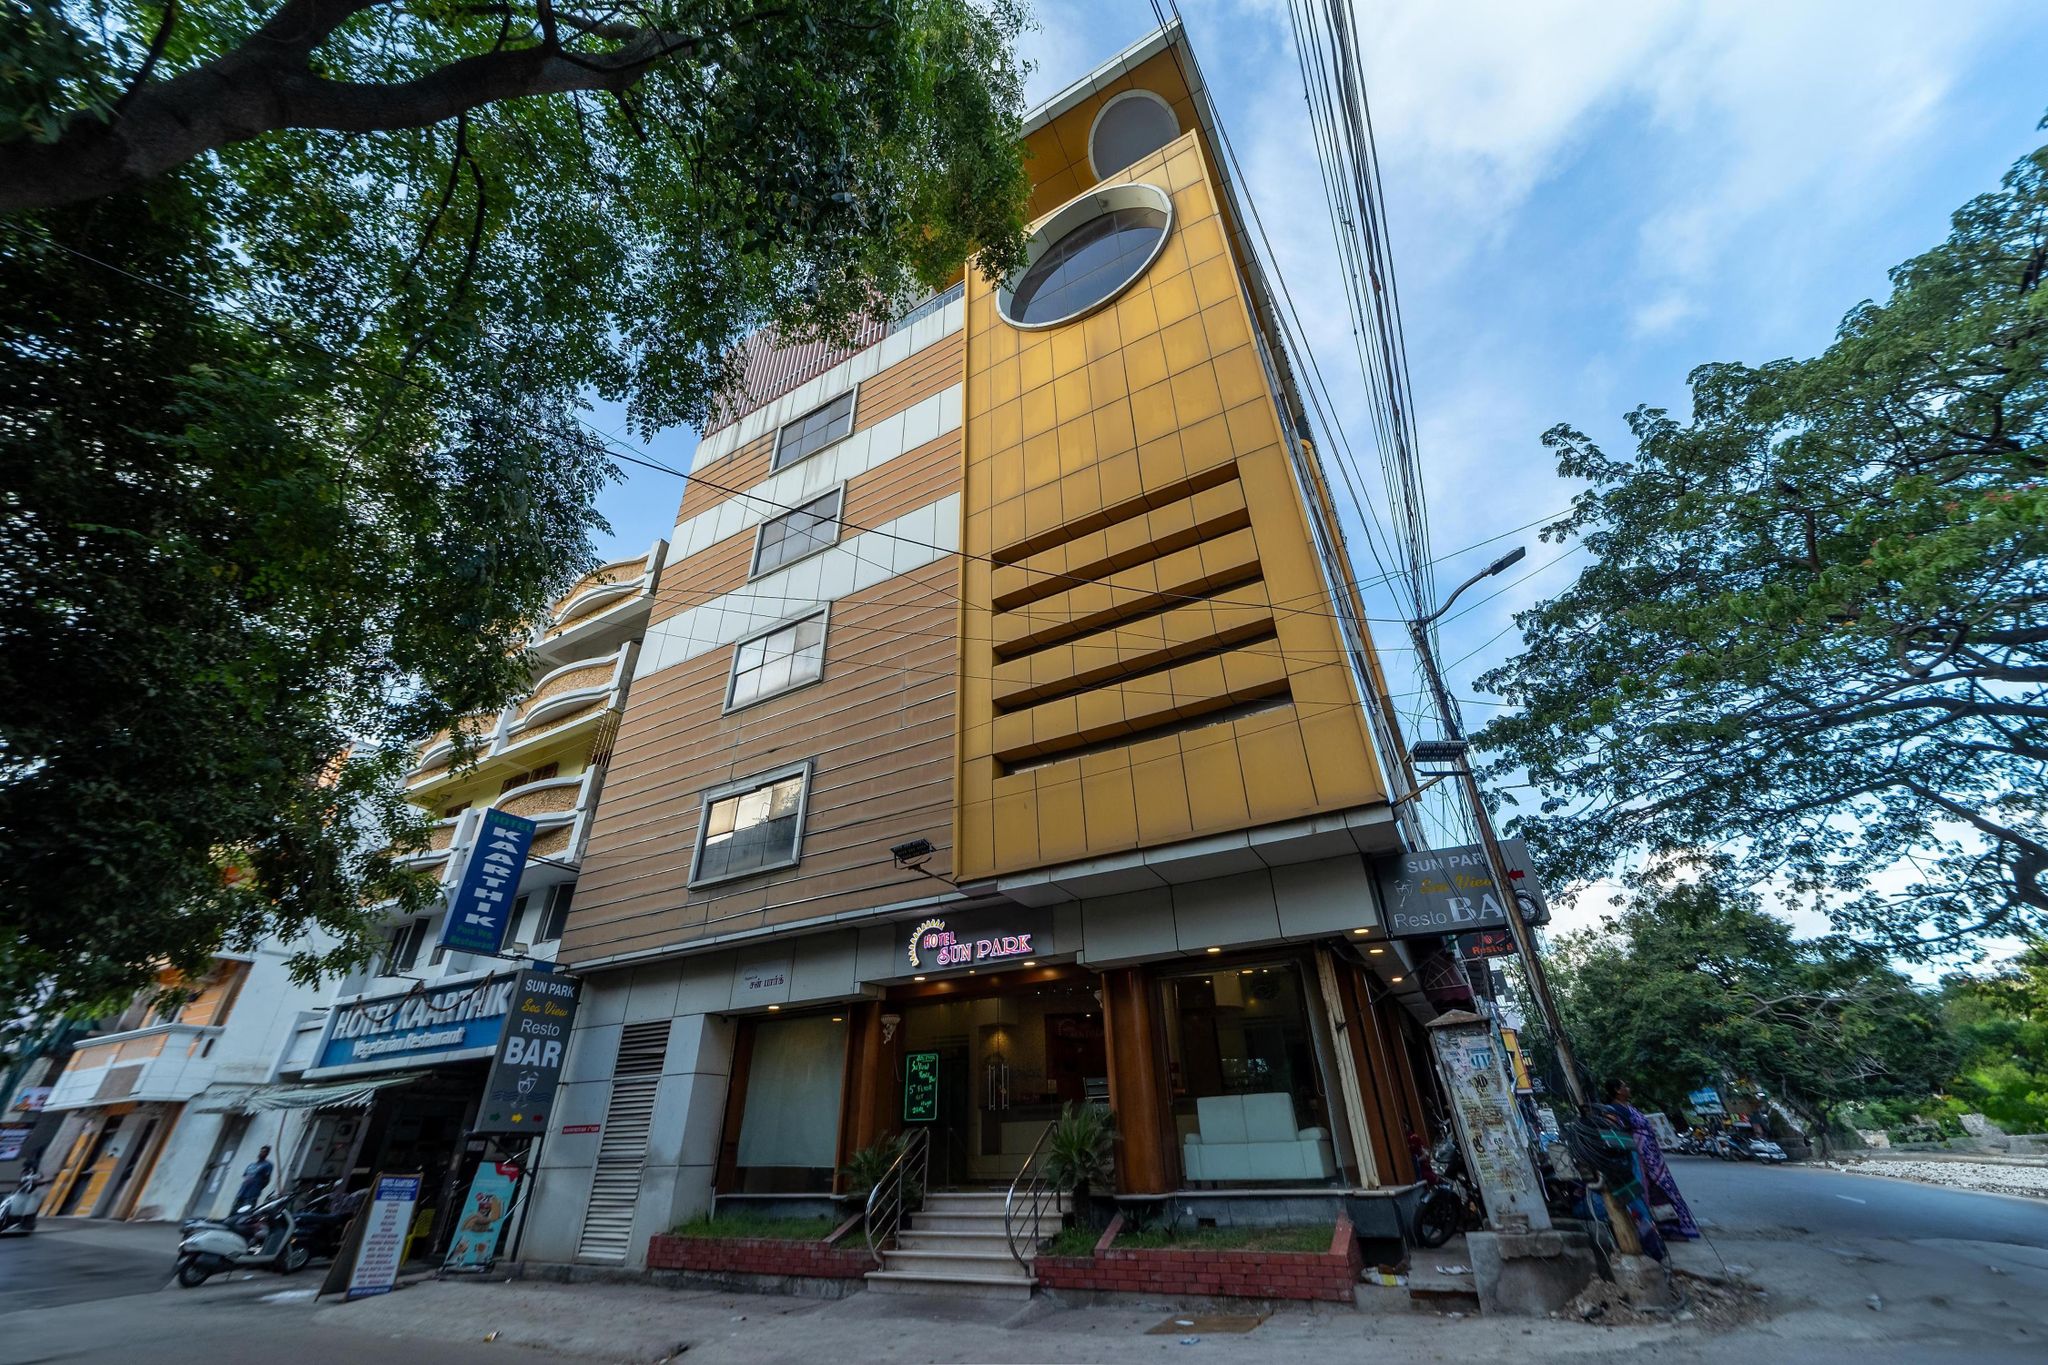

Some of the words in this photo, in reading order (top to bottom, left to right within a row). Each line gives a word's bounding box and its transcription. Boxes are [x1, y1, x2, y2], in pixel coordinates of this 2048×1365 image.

[1407, 858, 1444, 873] SUN
[1450, 853, 1483, 867] PAR
[465, 827, 522, 928] KAARTHIK
[1393, 911, 1447, 929] Resto
[1446, 893, 1510, 923] BA
[923, 931, 956, 949] HOTEL
[937, 943, 972, 965] SUN
[976, 933, 1033, 958] PARK
[525, 979, 547, 994] SUN
[549, 983, 575, 998] PARK
[331, 1003, 397, 1040] HOTEL
[395, 981, 515, 1031] KAARTHIK
[521, 998, 541, 1014] Sea
[544, 1001, 568, 1017] View
[404, 1026, 466, 1049] Restaurant
[520, 1018, 560, 1037] Resto
[503, 1036, 562, 1068] BAR
